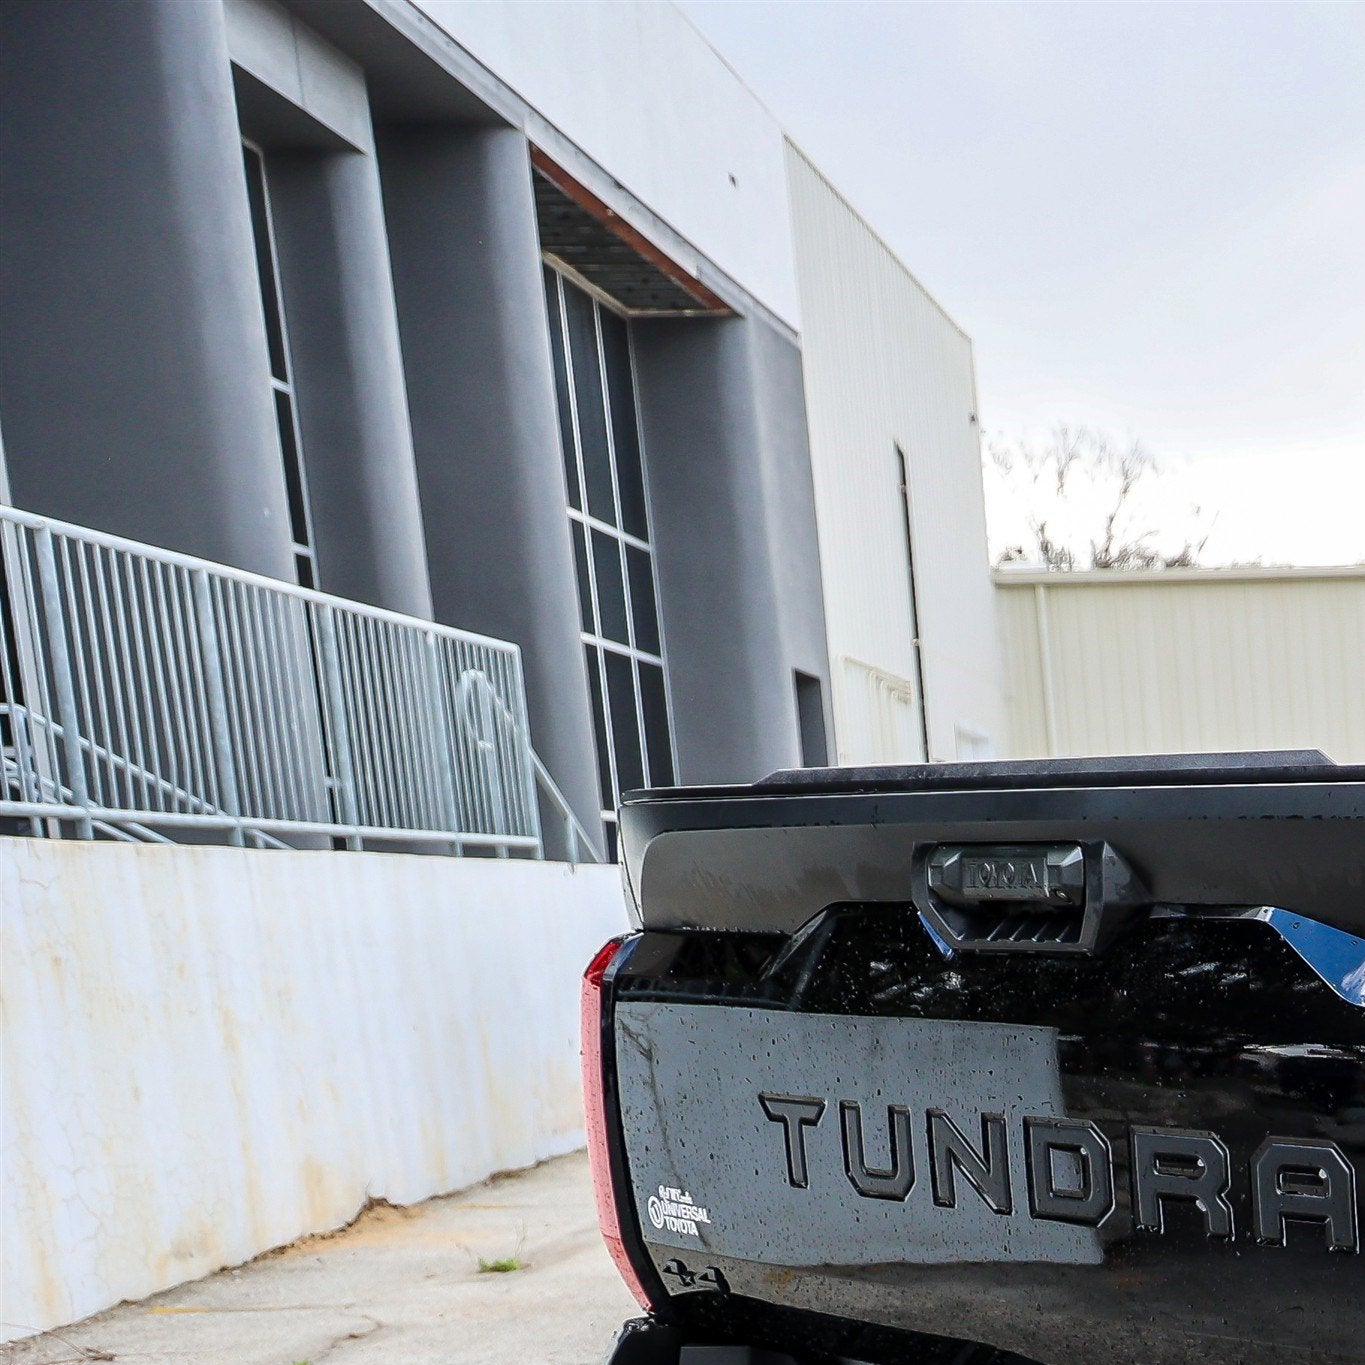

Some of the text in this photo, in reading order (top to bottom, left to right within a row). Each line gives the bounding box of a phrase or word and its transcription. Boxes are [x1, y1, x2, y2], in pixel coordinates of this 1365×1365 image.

[966, 861, 1043, 889] TOYOTA
[757, 1091, 1361, 1255] TUNDRA
[661, 1200, 711, 1224] UNIVERSAL
[664, 1216, 699, 1236] TOYOTA
